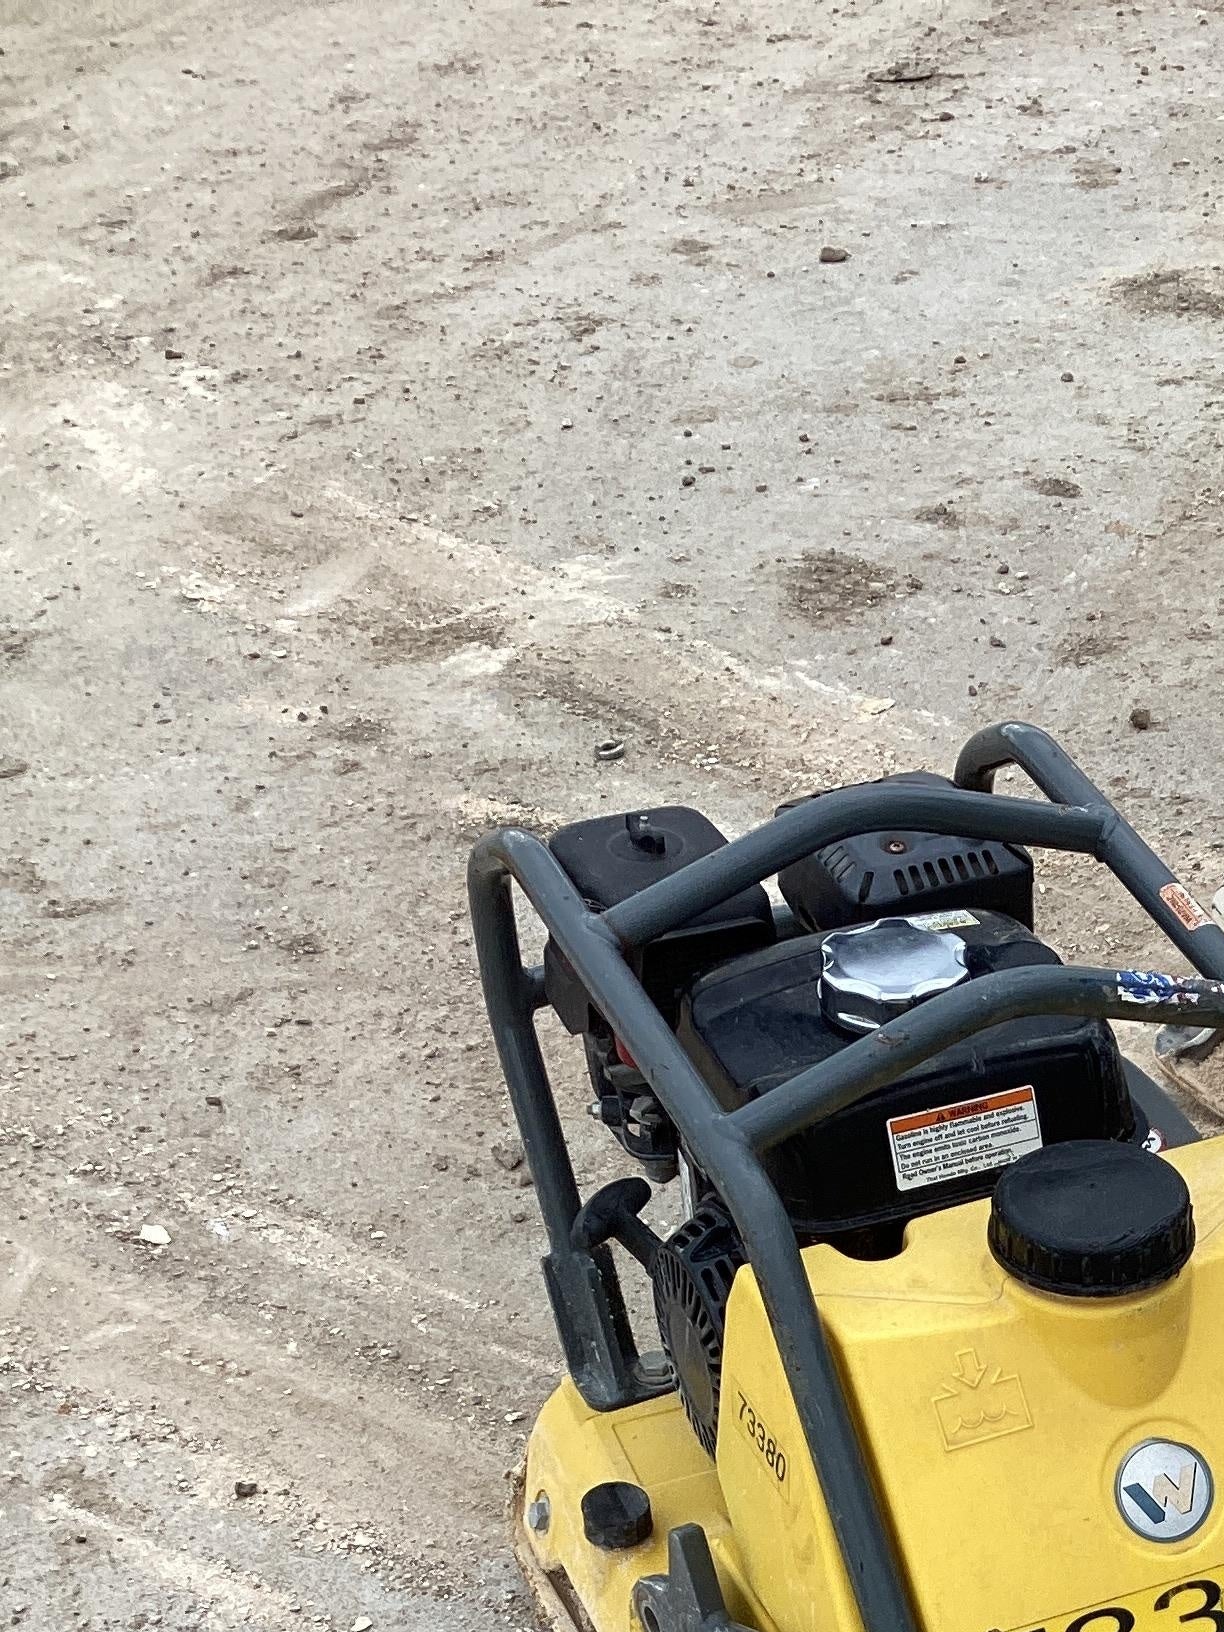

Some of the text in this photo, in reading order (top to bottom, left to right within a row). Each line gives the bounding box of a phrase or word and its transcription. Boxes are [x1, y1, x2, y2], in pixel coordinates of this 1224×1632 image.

[895, 1130, 921, 1141] Gasoline
[929, 1123, 948, 1134] highly
[949, 1115, 981, 1128] flammable
[995, 1105, 1024, 1117] explosive.
[948, 1101, 988, 1118] WARNING
[897, 1141, 911, 1149] Turn
[912, 1137, 933, 1147] engine
[943, 1130, 956, 1138] and
[965, 1124, 979, 1133] cool
[980, 1119, 1000, 1129] before
[899, 1125, 1021, 1160] The engine emits toxic carbon monoxide.
[950, 1145, 977, 1157] enclosed
[978, 1142, 992, 1150] area.
[902, 1170, 917, 1179] Read
[918, 1164, 941, 1175] Owner's
[942, 1159, 963, 1169] Manual
[964, 1154, 983, 1163] before
[738, 1391, 786, 1482] 73380
